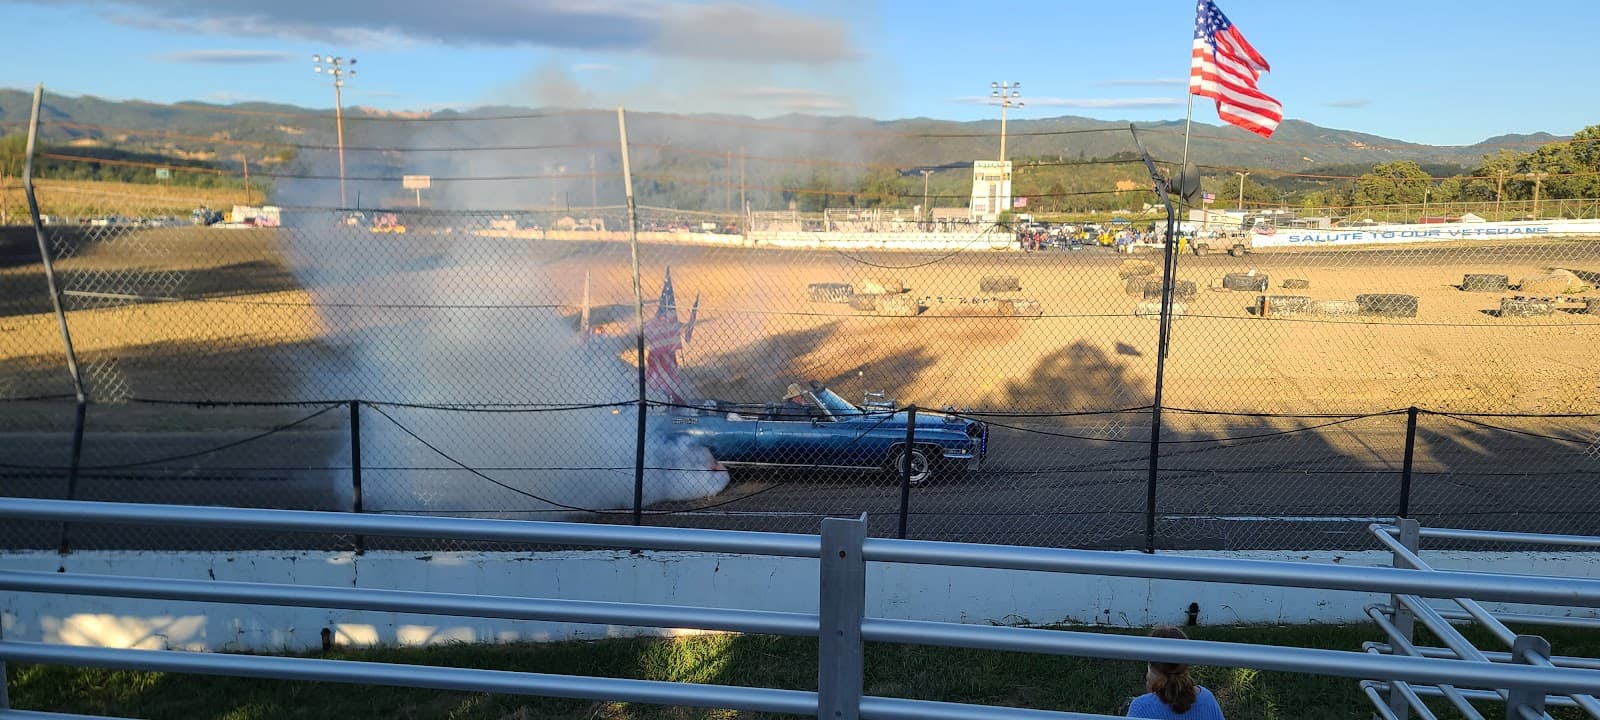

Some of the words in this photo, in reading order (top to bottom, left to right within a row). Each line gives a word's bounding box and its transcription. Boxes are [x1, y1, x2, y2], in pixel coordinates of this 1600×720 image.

[1288, 232, 1364, 243] SALUTE
[1371, 231, 1395, 239] TO
[1401, 229, 1441, 238] OUR
[1448, 227, 1549, 237] VETERANS
